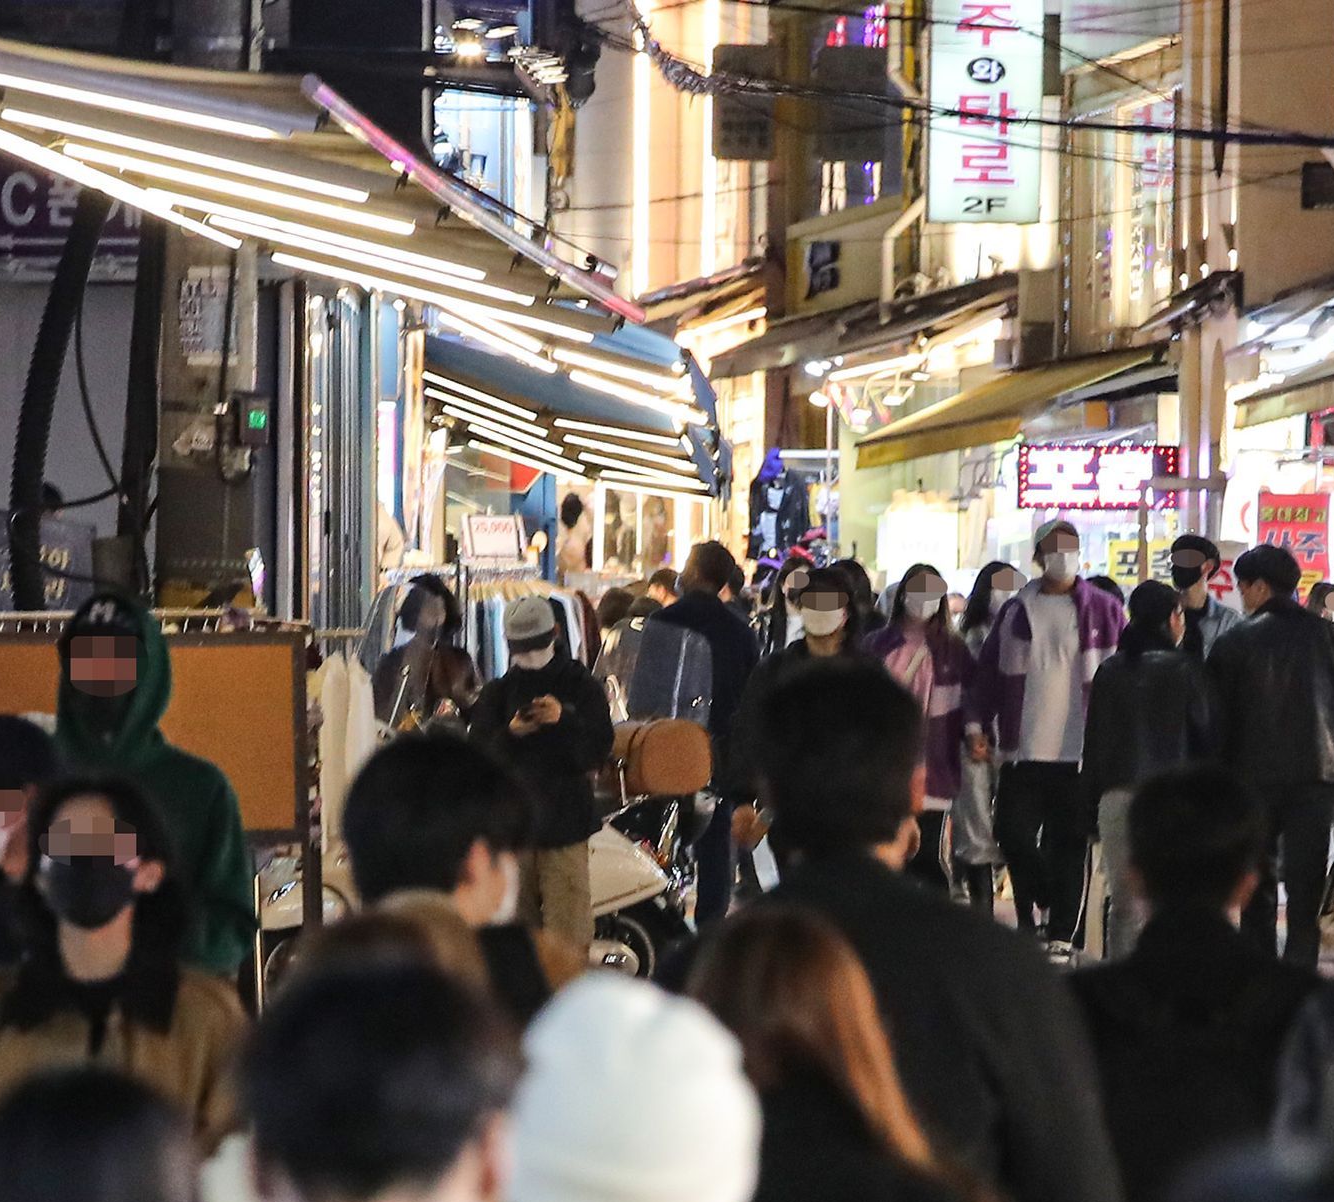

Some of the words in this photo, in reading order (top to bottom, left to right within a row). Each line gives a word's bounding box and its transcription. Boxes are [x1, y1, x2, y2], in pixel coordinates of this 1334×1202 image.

[972, 60, 1001, 83] 와
[953, 92, 1018, 184] 타로
[962, 197, 1008, 214] 2F
